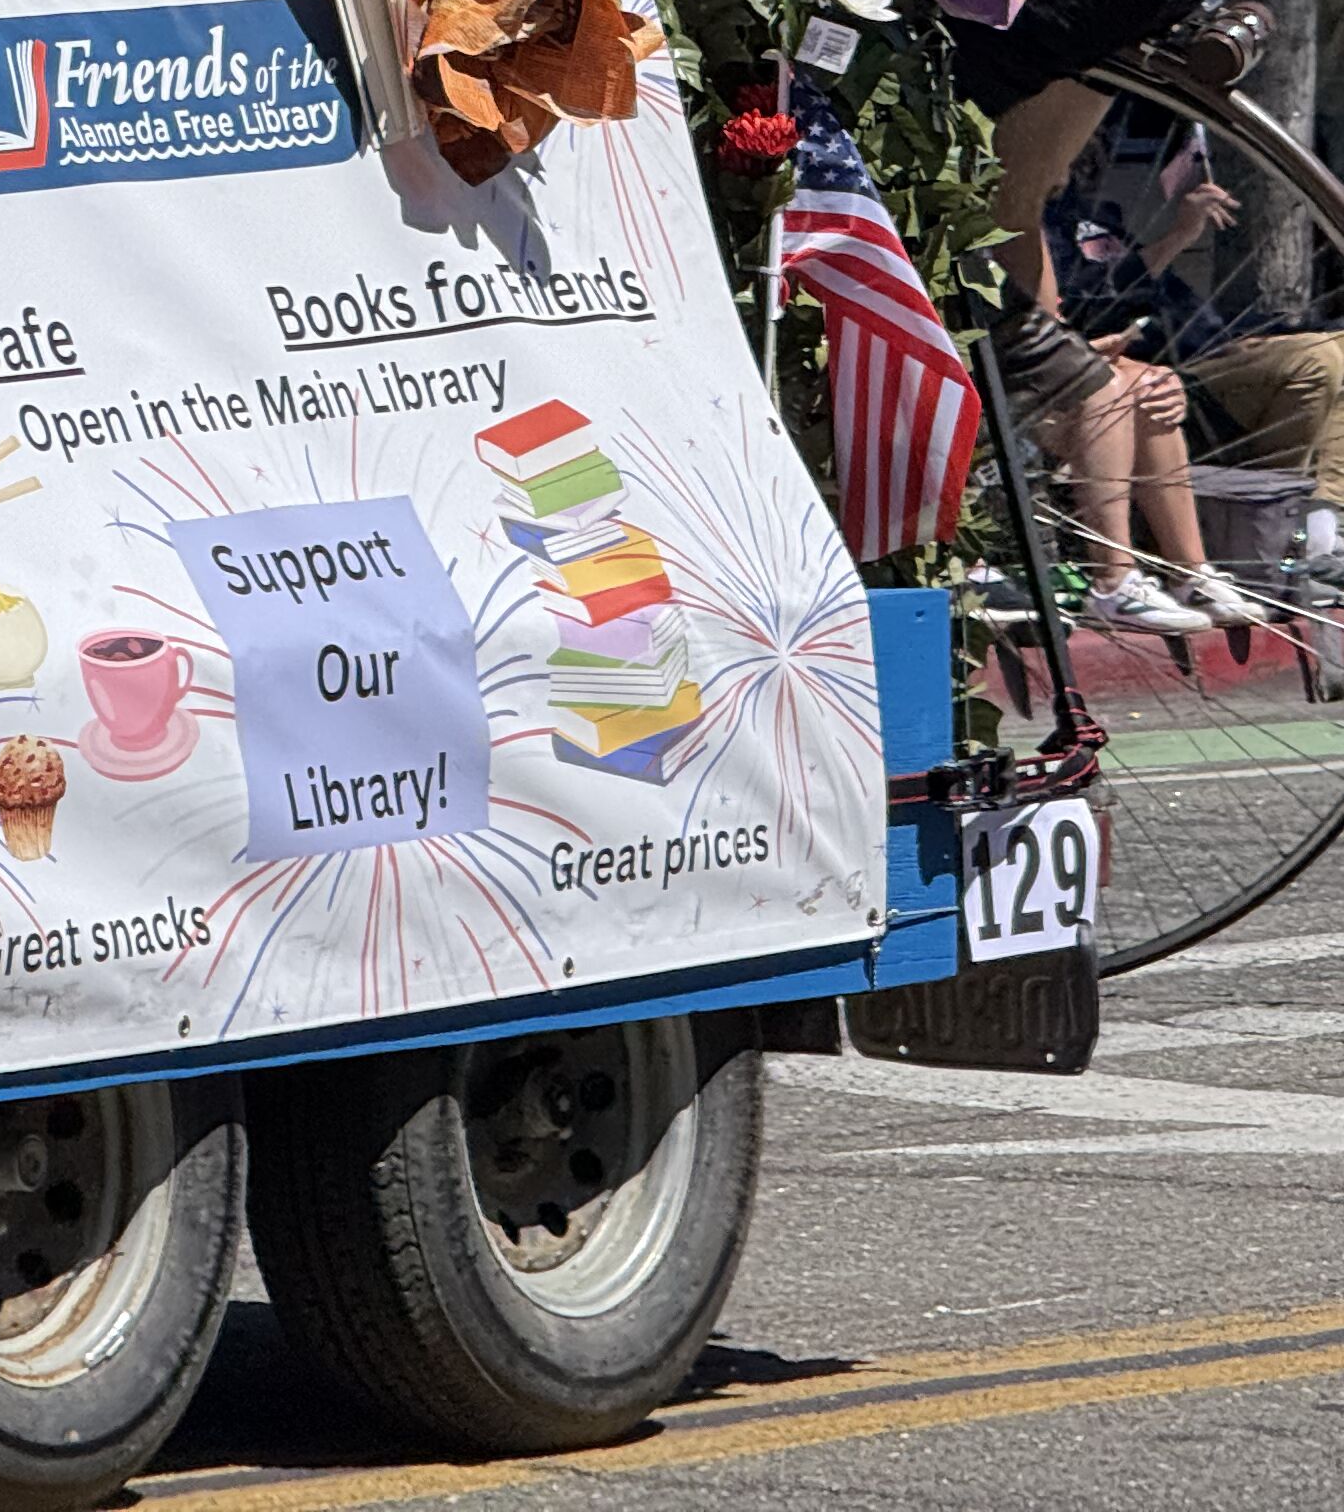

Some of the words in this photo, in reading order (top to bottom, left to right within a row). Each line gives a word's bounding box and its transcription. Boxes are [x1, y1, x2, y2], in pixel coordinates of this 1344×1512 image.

[54, 25, 249, 109] Friends
[255, 46, 285, 106] of
[288, 42, 338, 91] the
[59, 110, 171, 149] Alameda
[173, 109, 235, 141] Free
[238, 99, 339, 146] Library
[265, 273, 416, 341] Books
[424, 260, 502, 323] for
[494, 257, 649, 316] Friends
[18, 403, 134, 464] Open
[131, 390, 183, 438] in
[182, 383, 253, 434] the
[256, 369, 357, 429] Main
[357, 359, 508, 414] Library
[211, 530, 407, 605] Support
[316, 643, 400, 703] Our
[284, 751, 448, 831] Library!
[550, 834, 654, 893] Great
[661, 818, 770, 891] prices
[970, 818, 1089, 942] 129
[91, 895, 212, 963] snacks
